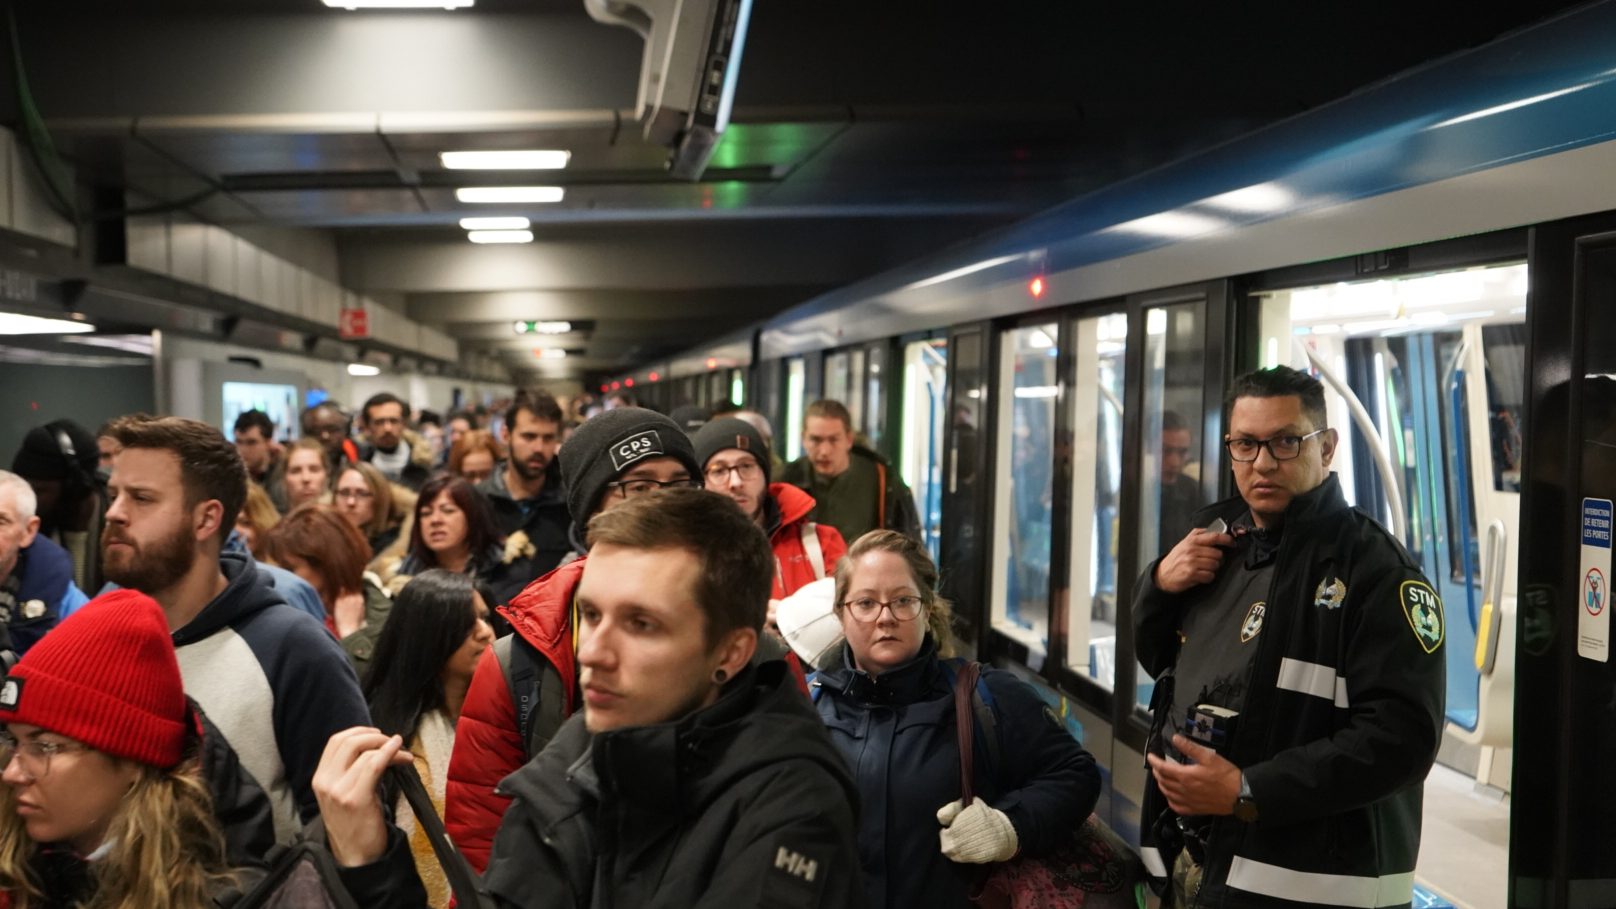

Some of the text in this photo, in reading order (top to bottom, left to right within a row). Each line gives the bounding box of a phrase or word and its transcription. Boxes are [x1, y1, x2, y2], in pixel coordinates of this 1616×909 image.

[620, 437, 651, 456] CPS
[1584, 518, 1610, 528] DE RETENIR
[1584, 529, 1609, 541] LES PORTES
[1409, 587, 1436, 609] STM
[775, 846, 818, 882] HH
